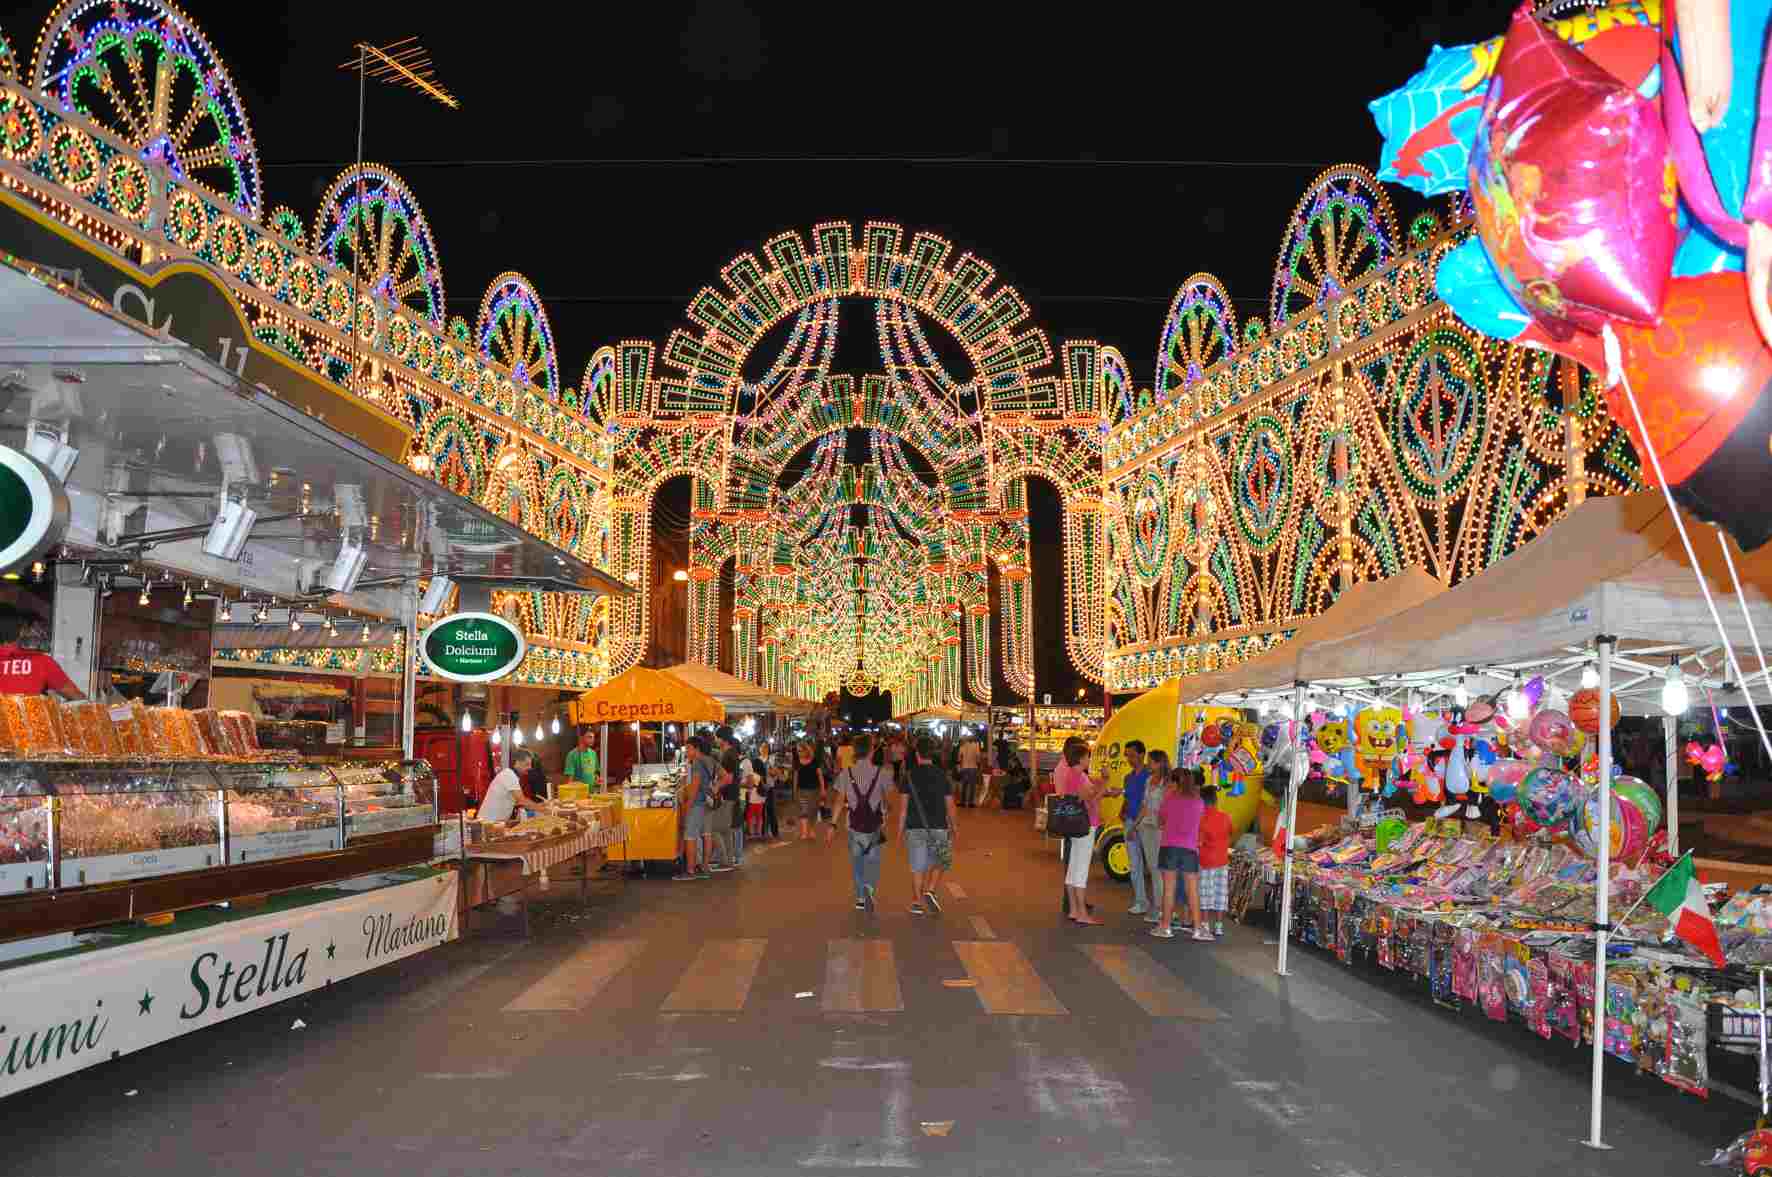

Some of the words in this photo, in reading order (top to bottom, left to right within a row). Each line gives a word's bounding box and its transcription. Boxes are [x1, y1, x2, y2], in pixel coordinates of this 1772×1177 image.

[455, 630, 488, 641] Stella
[444, 645, 497, 656] Dolciumi
[2, 658, 32, 676] TED
[596, 698, 675, 719] Creperia
[179, 931, 310, 1019] Stella
[362, 912, 448, 960] Mariano
